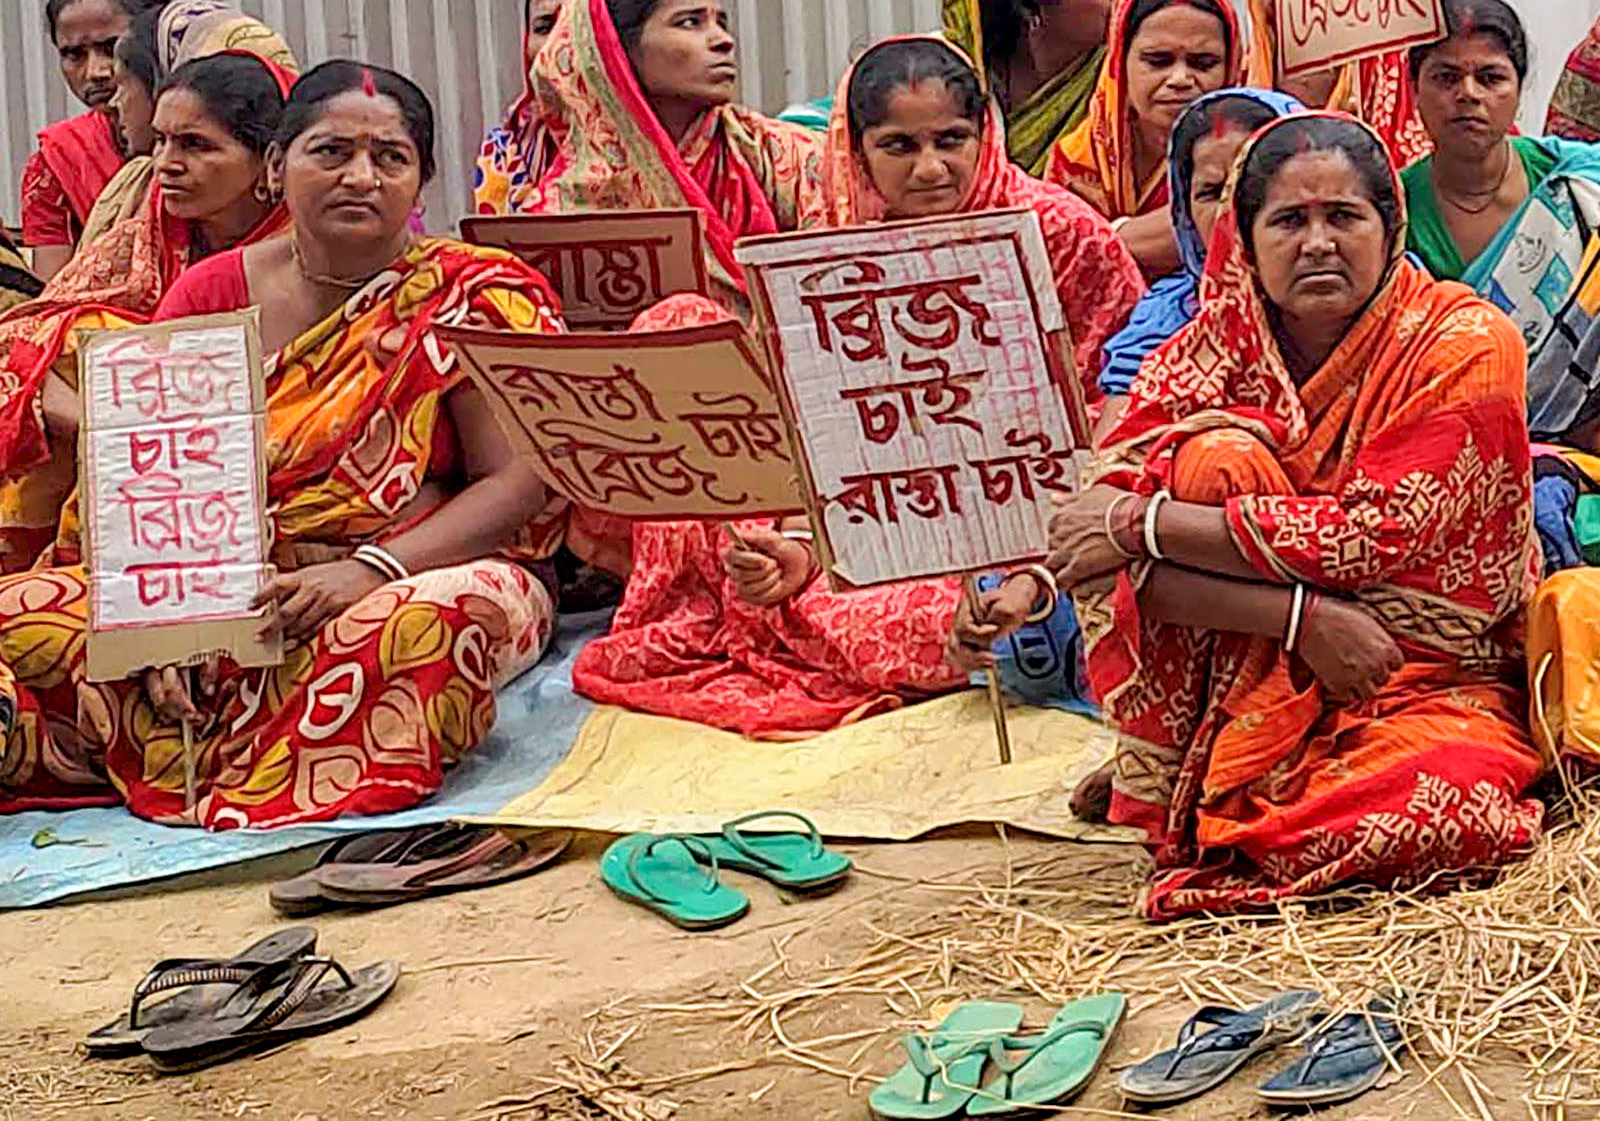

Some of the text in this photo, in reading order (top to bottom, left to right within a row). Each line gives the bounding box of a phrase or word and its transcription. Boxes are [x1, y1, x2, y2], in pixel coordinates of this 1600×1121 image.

[800, 260, 1003, 363] ব্রিজ
[121, 412, 229, 476] চাই
[489, 362, 792, 463] রাস্তা চাই
[839, 351, 990, 445] চাই
[832, 428, 1077, 526] রাস্তা চাই
